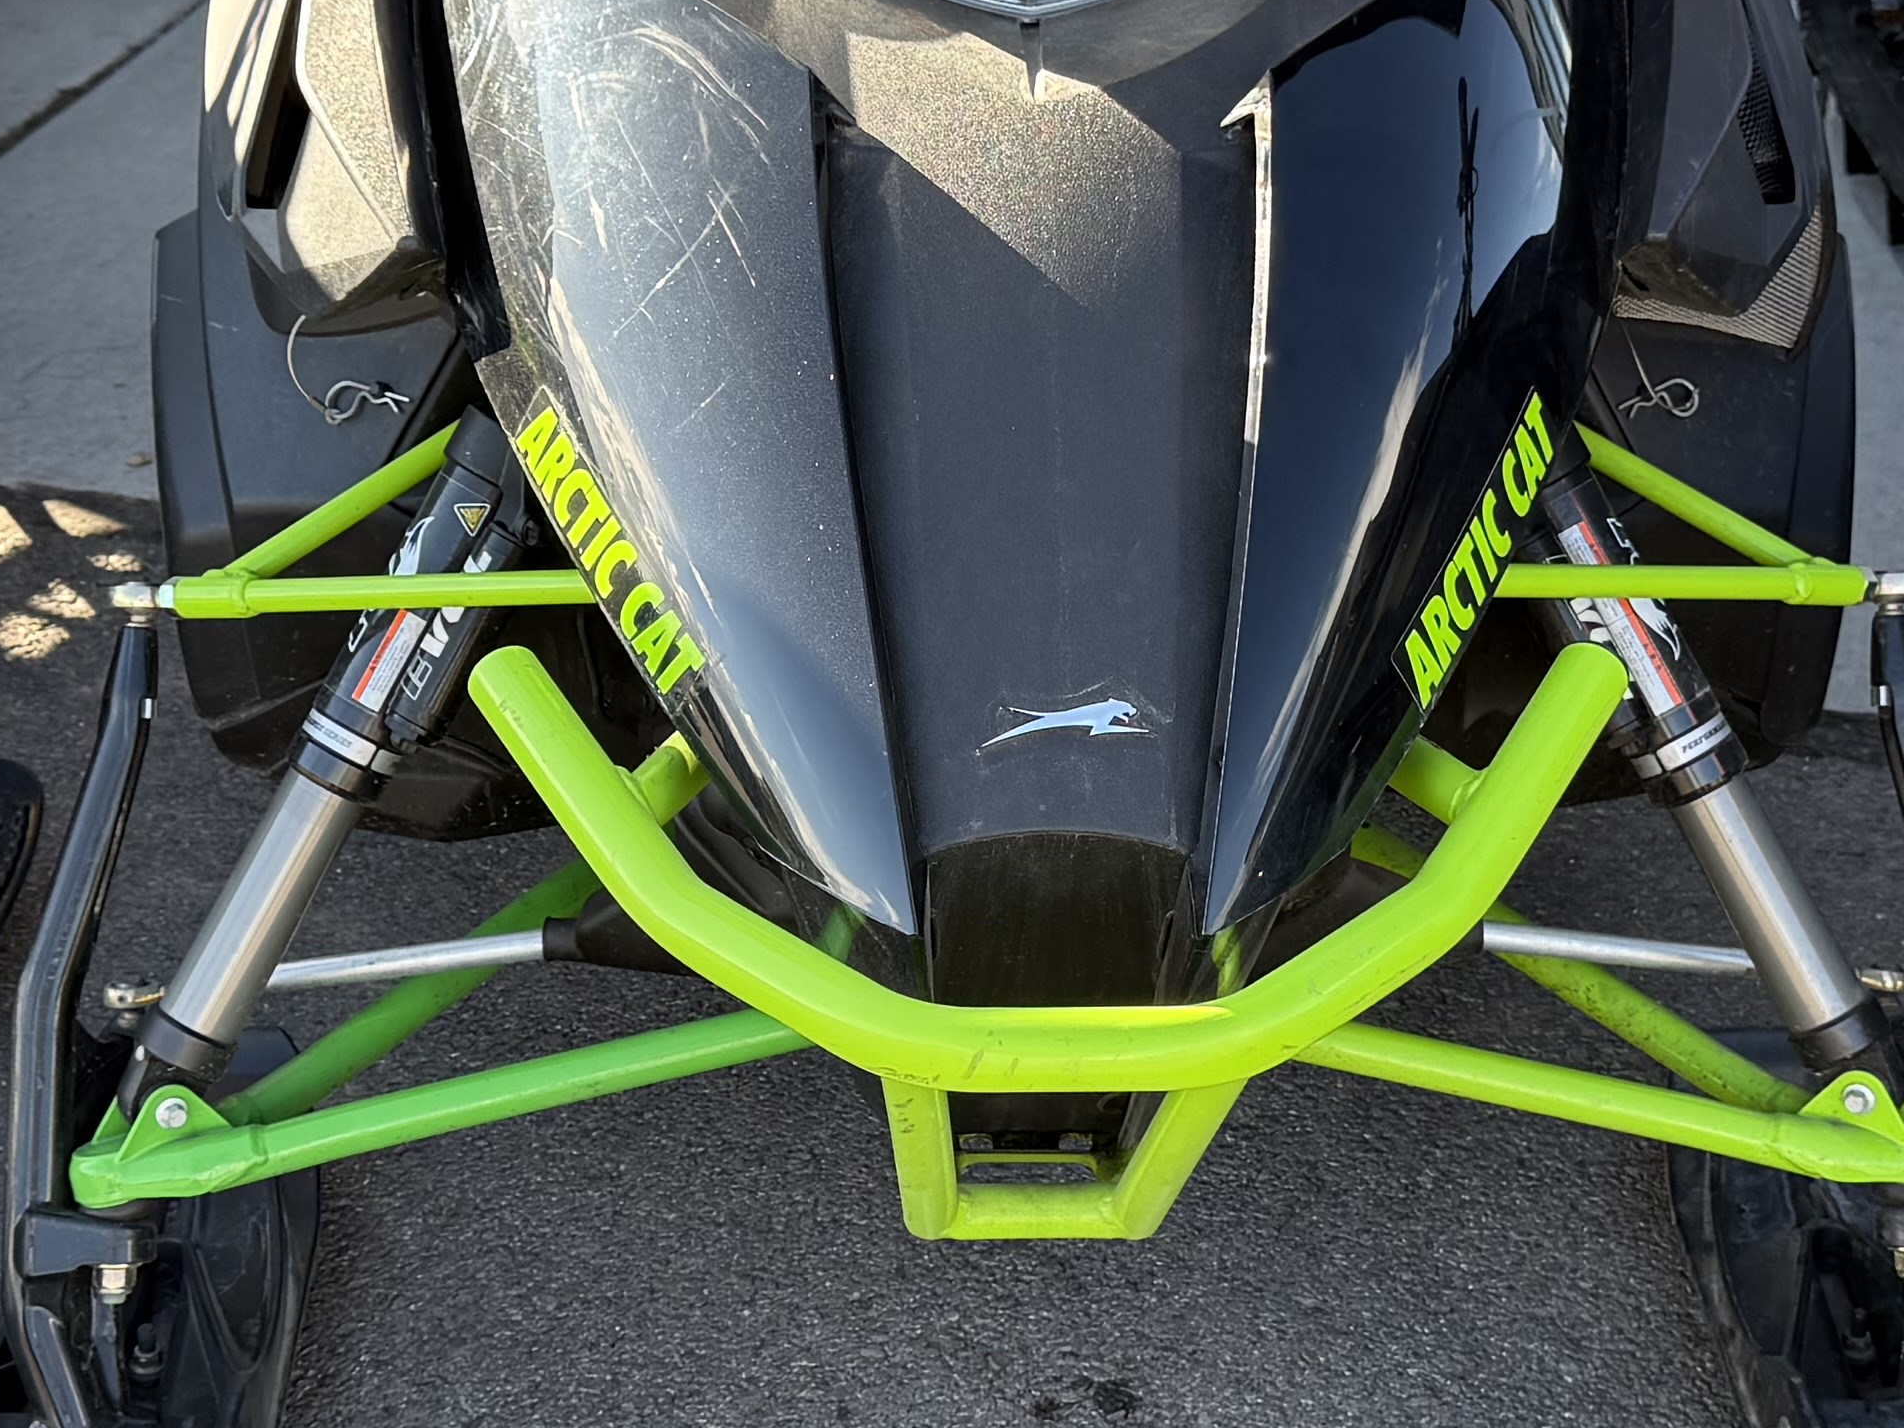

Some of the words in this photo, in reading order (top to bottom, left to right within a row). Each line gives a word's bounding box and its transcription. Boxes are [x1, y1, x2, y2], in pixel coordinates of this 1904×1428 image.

[515, 406, 638, 600] ARCTIC
[619, 581, 707, 695] CAT
[1404, 487, 1513, 710] ARCTIC
[1501, 391, 1554, 518] CAT
